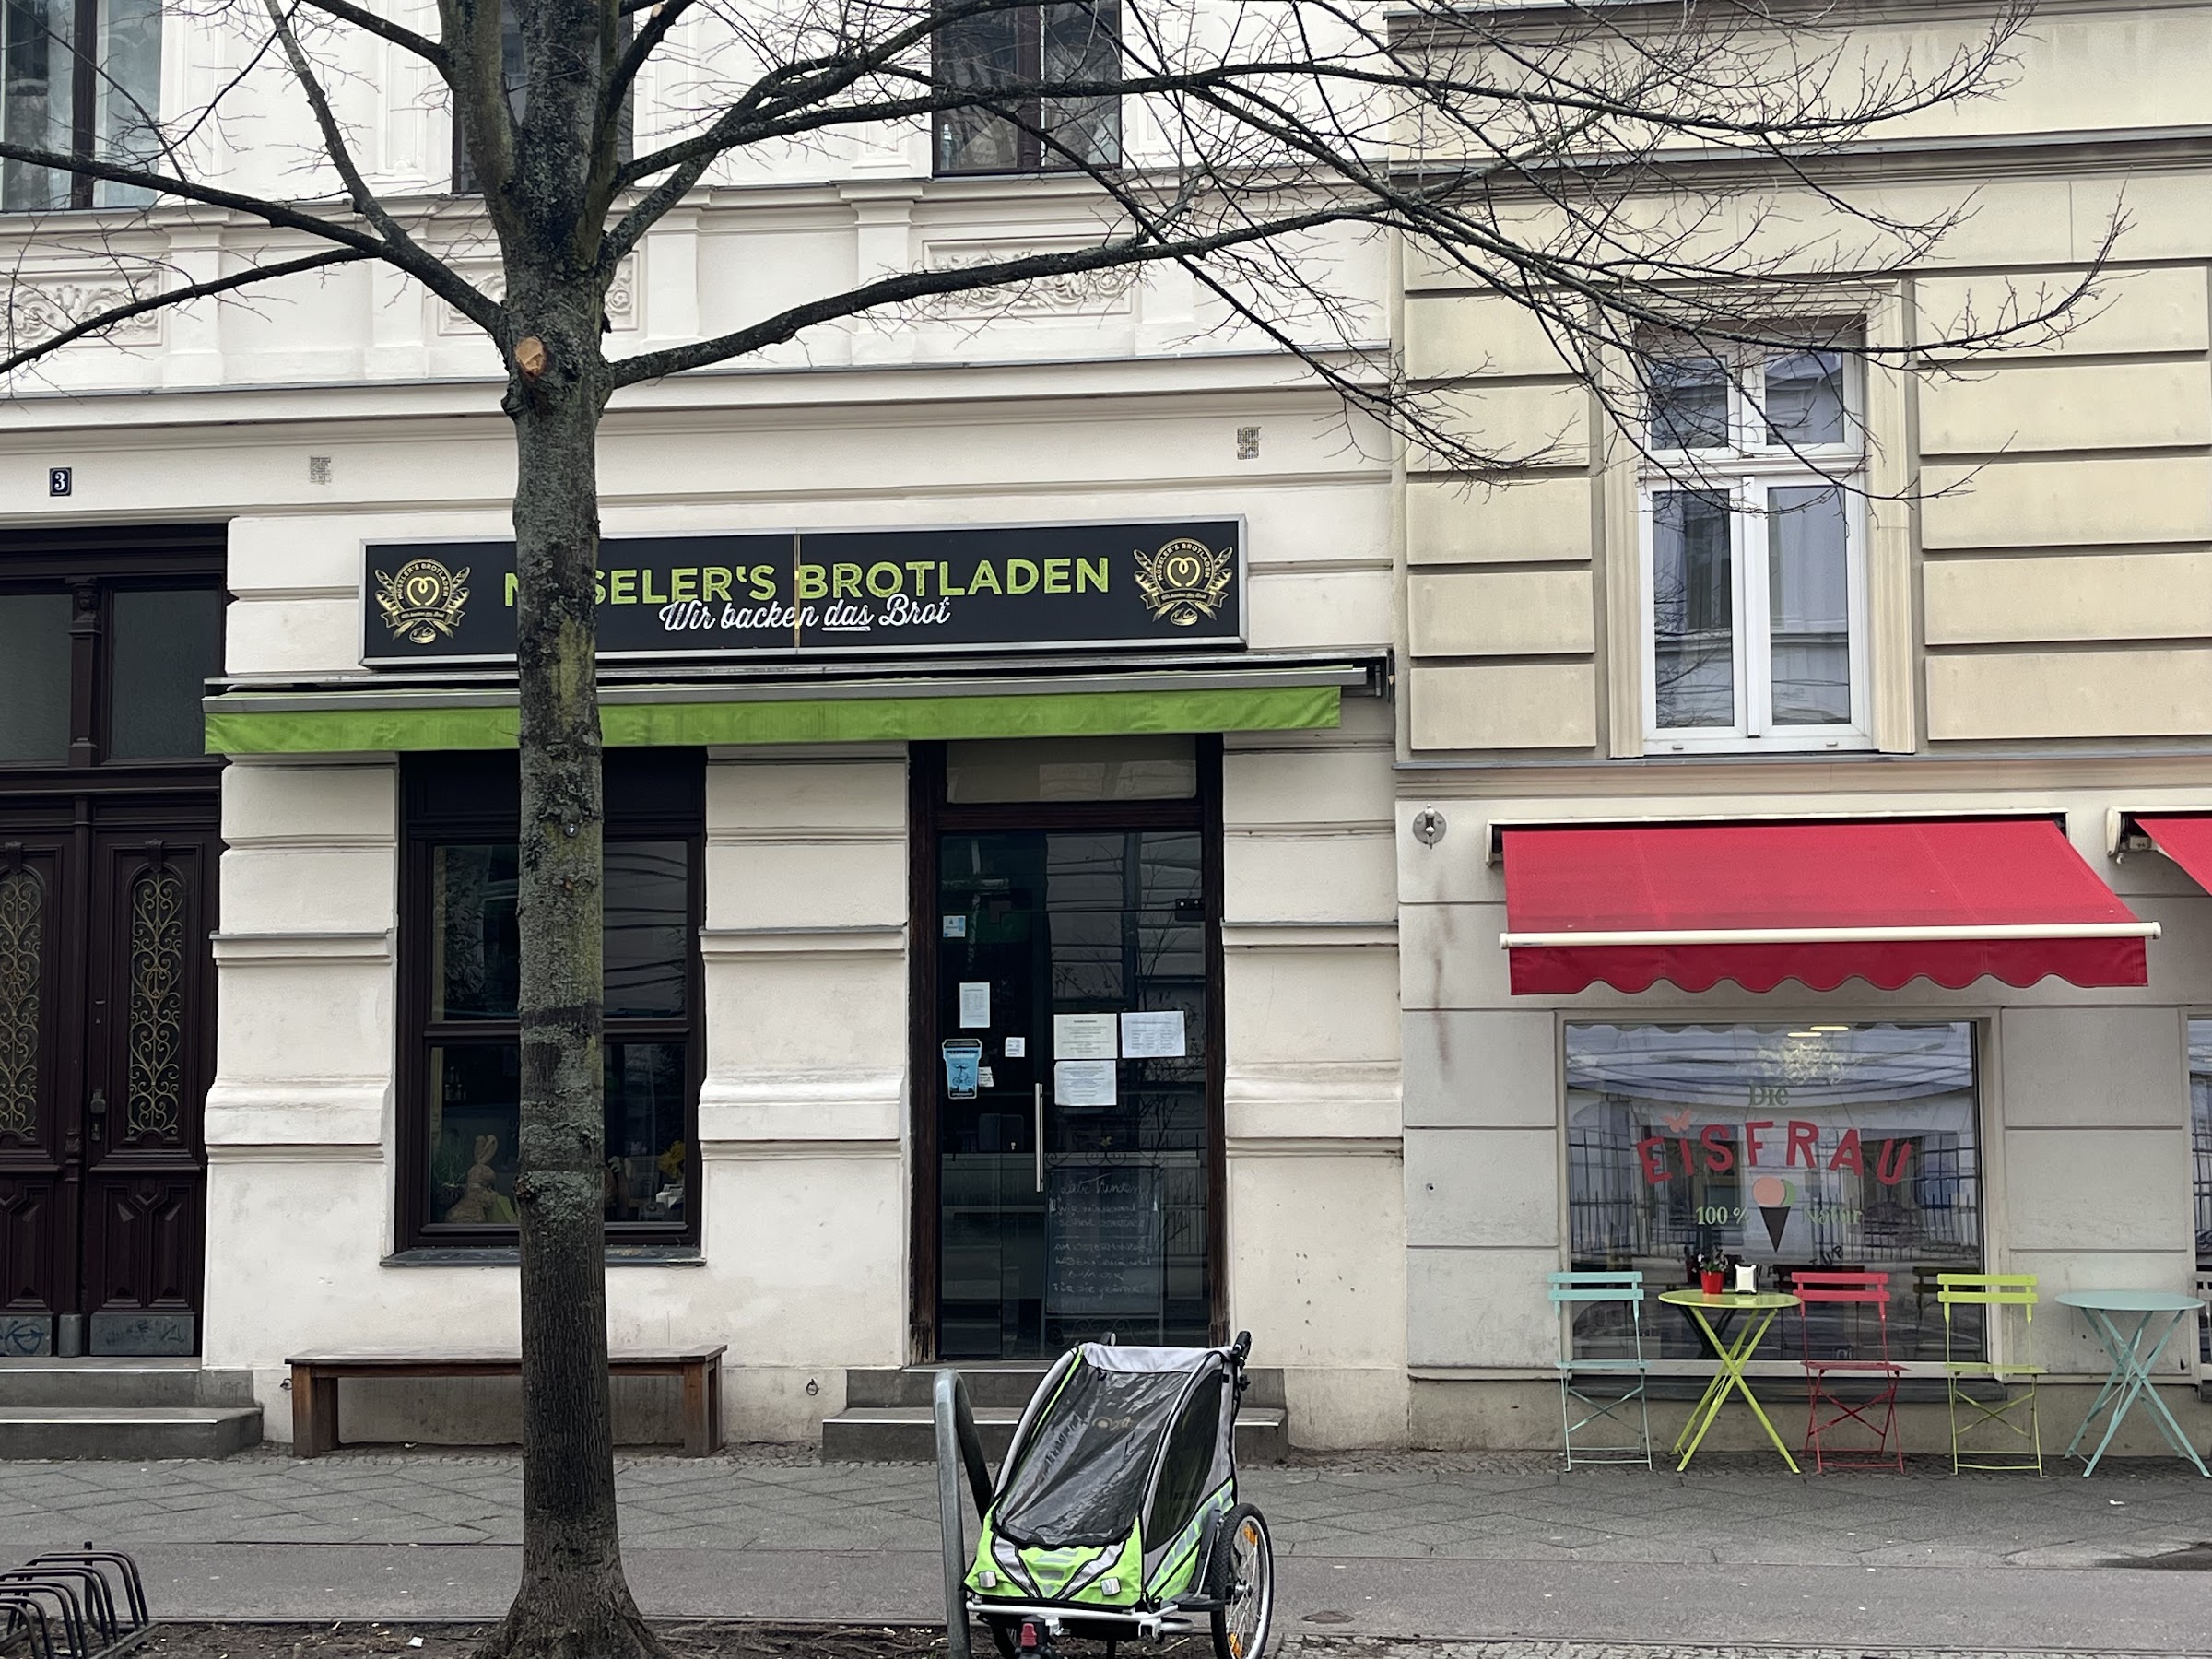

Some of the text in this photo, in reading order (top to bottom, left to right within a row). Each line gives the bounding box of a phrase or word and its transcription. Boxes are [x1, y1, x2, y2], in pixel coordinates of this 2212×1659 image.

[54, 471, 66, 491] 3
[504, 557, 1110, 607] ELER'S BROTLADEN
[659, 593, 951, 631] Wir backen das Brot
[1748, 1083, 1789, 1106] Die
[1636, 1120, 1913, 1186] EISFRAU
[1696, 1206, 1729, 1226] 100
[1803, 1205, 1864, 1226] Natur
